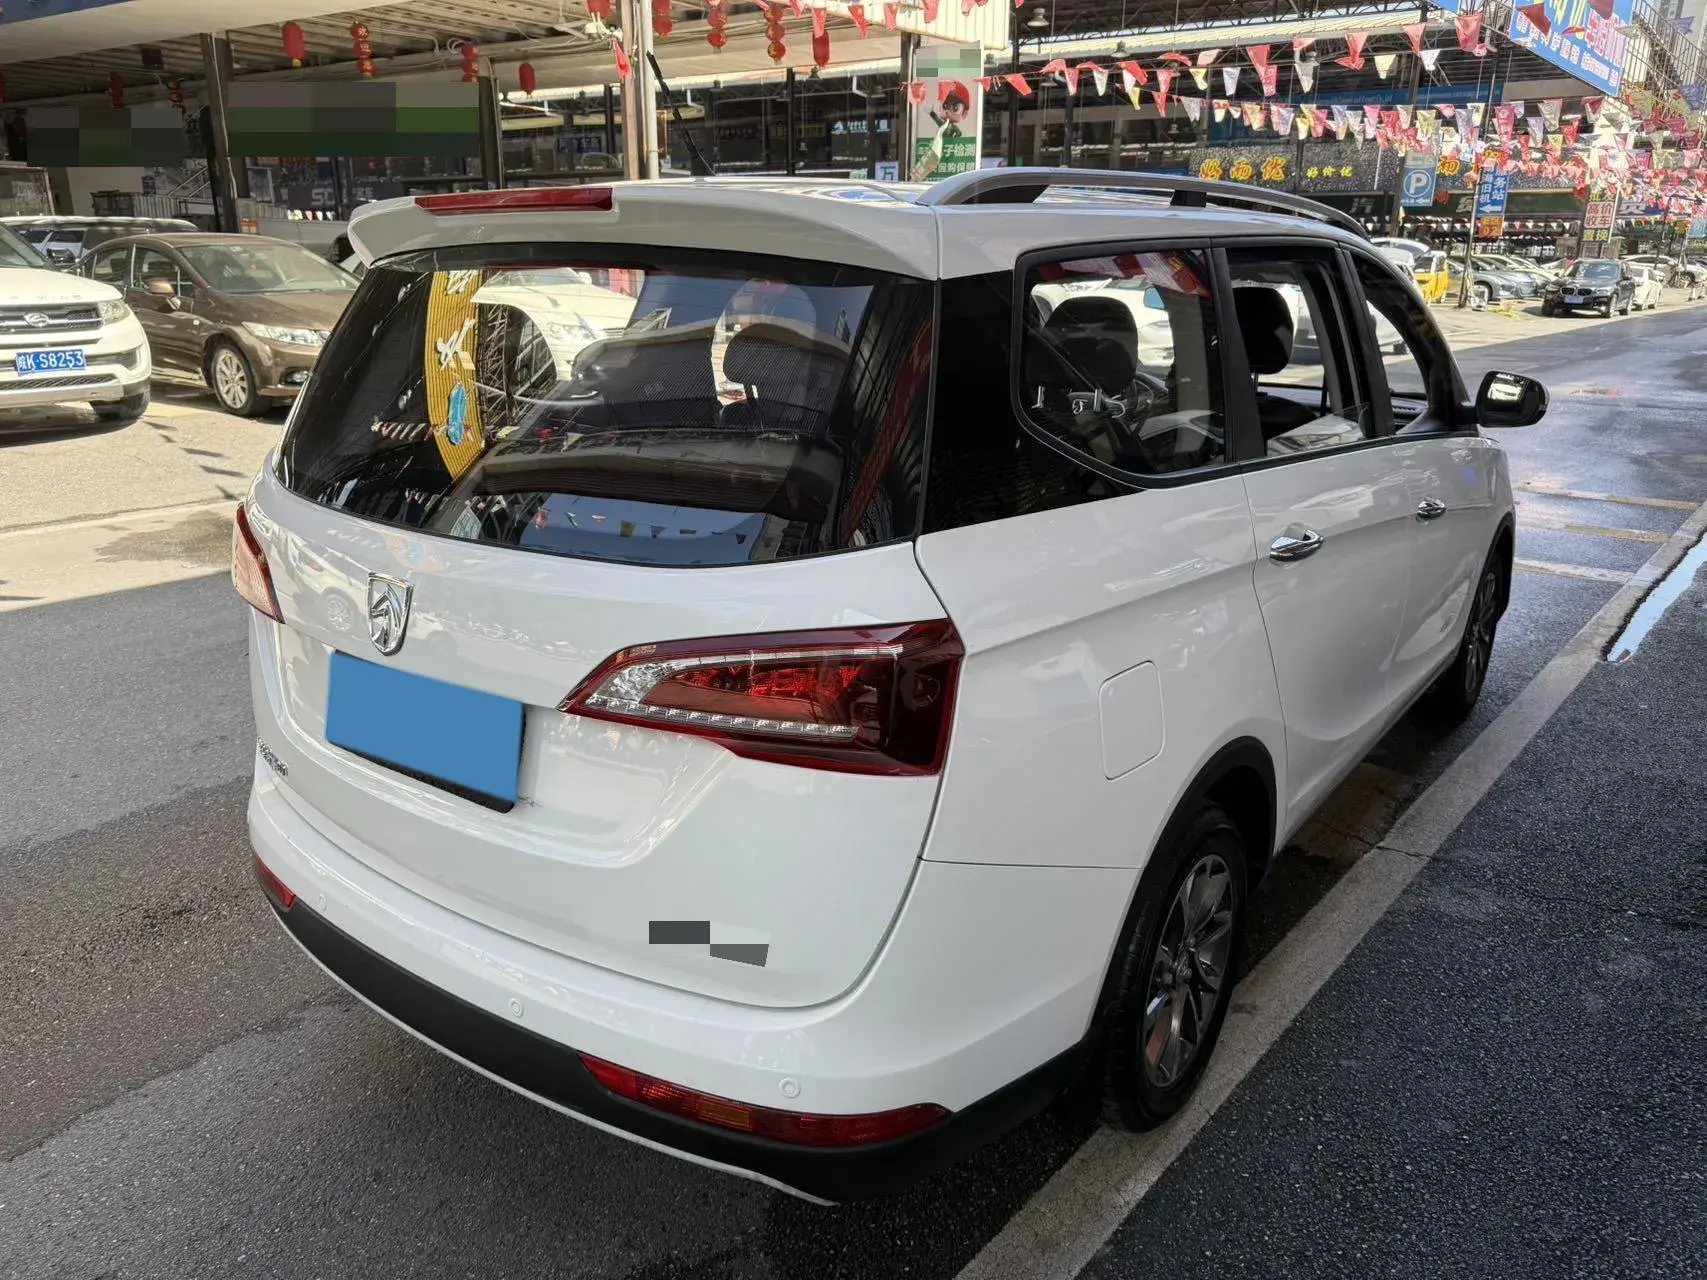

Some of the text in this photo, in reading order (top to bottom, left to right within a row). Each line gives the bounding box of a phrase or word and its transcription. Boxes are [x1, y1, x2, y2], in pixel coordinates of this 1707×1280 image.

[1409, 173, 1427, 195] P
[1587, 203, 1613, 214] 高价
[1586, 215, 1611, 226] 收车
